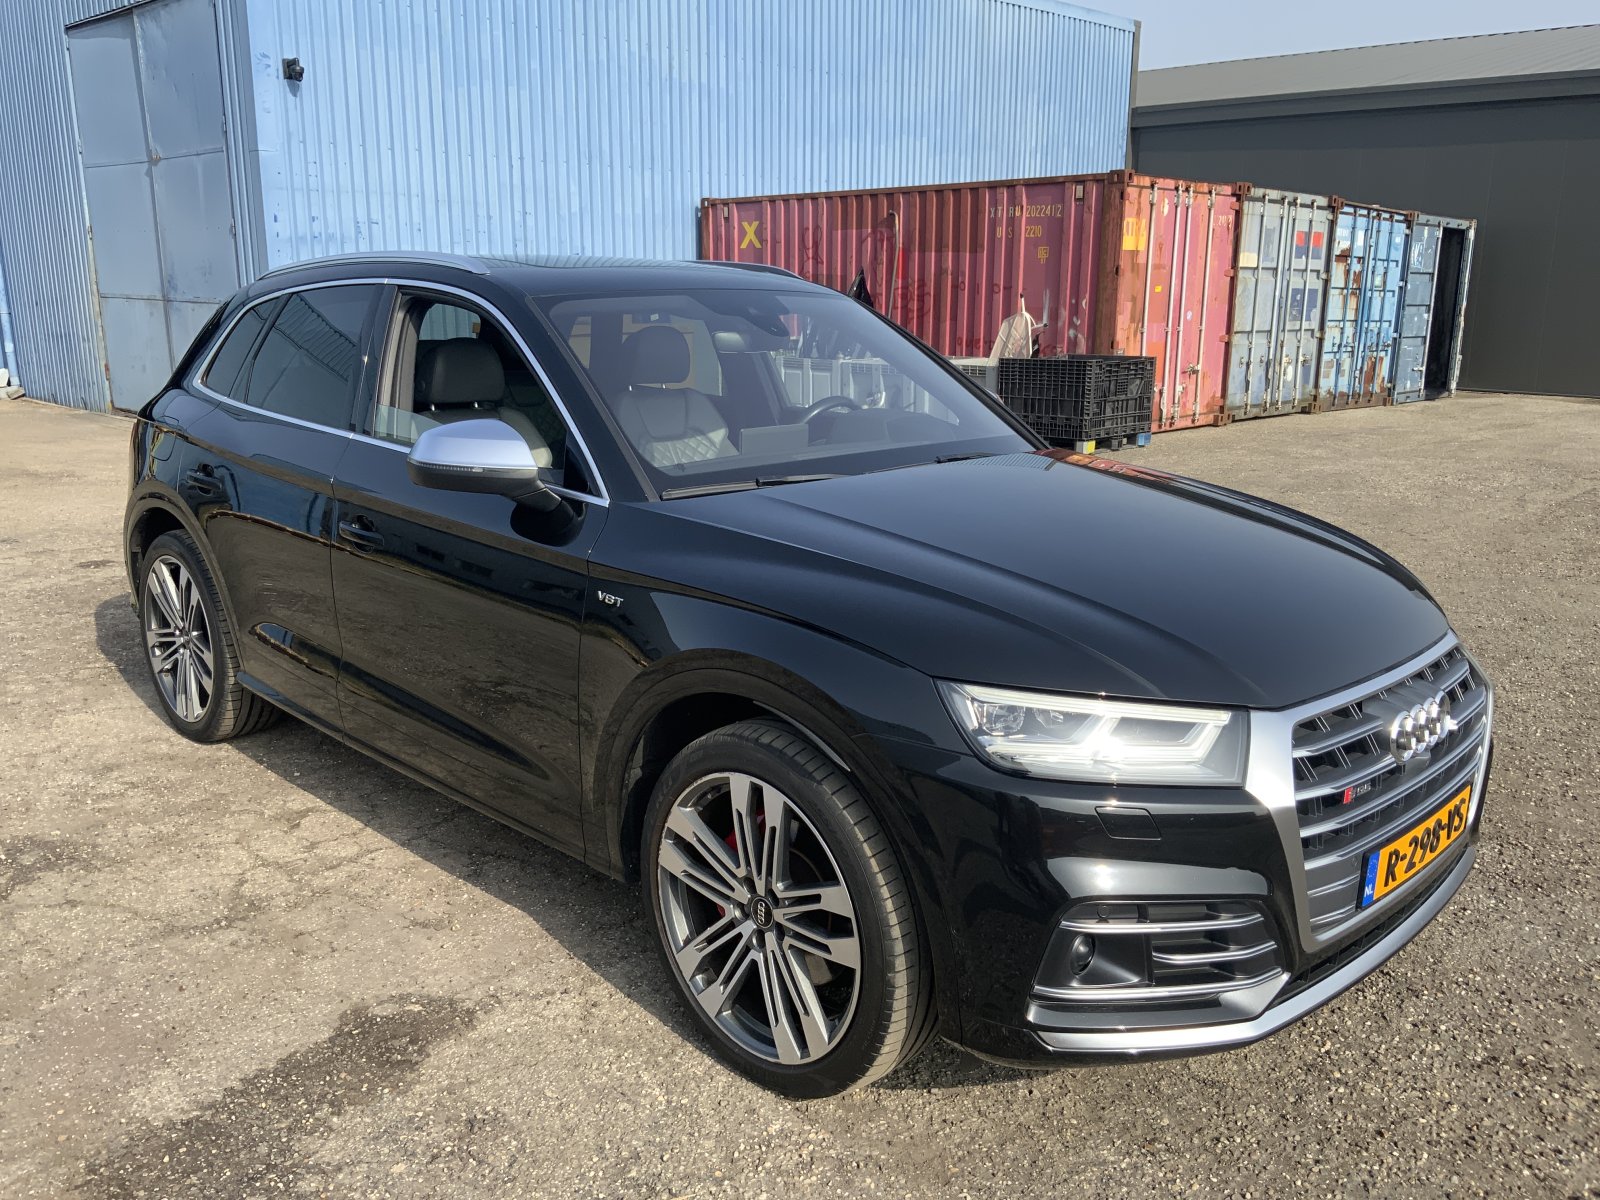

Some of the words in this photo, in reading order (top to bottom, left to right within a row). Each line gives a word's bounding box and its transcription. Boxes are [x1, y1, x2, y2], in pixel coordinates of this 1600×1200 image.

[740, 221, 762, 249] X
[1025, 224, 1042, 238] 2210
[1383, 797, 1466, 888] R-298-VS
[1363, 884, 1374, 898] NL
